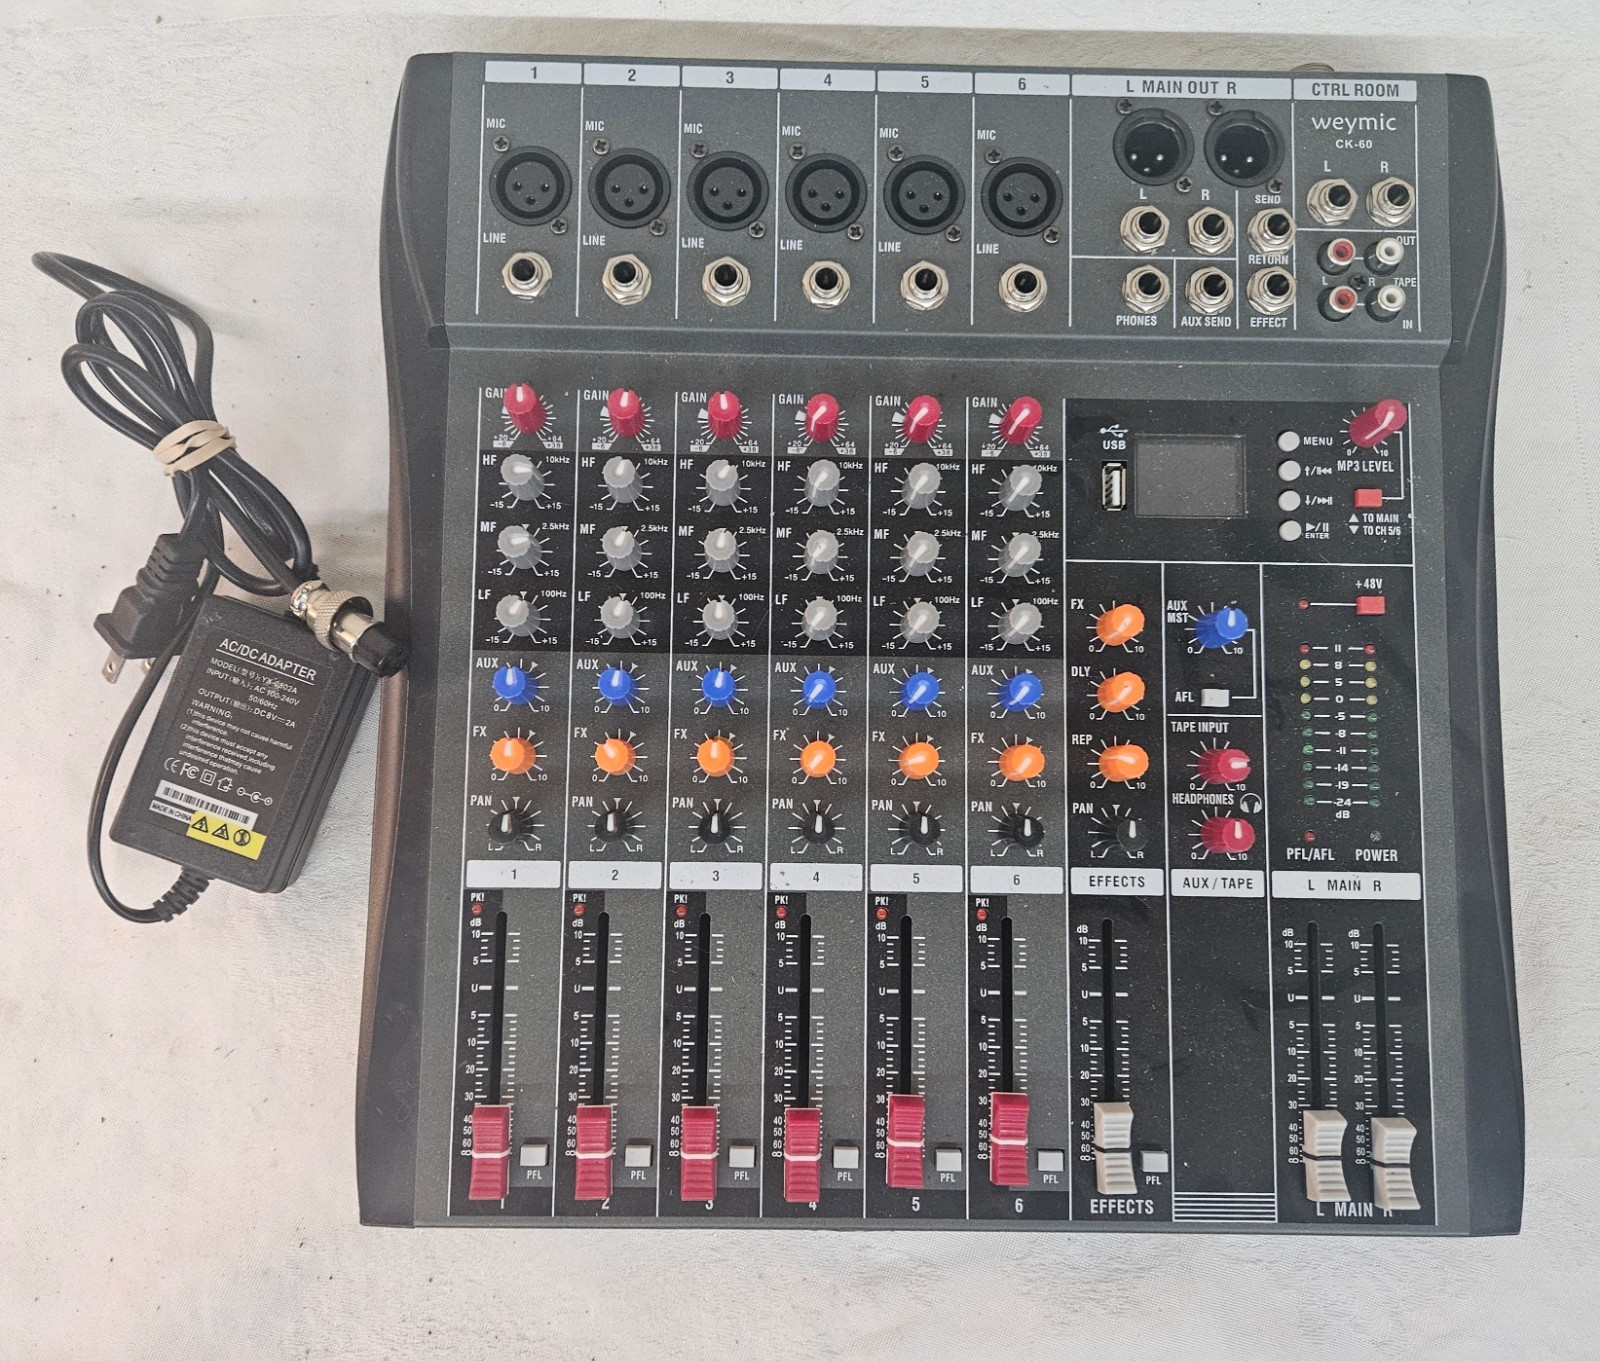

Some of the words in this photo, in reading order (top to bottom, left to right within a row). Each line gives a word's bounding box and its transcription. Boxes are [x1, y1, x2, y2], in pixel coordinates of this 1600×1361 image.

[531, 67, 537, 79] 1
[627, 69, 637, 82] 2
[726, 71, 734, 84] 3
[823, 74, 832, 87] 4
[921, 76, 929, 88] 5
[1018, 78, 1026, 90] 6
[1127, 80, 1134, 93] L
[1142, 81, 1183, 94] MAIN
[1187, 81, 1219, 95] OUT
[1227, 82, 1237, 95] R
[1312, 83, 1350, 97] CTRL
[1354, 84, 1399, 97] ROOM
[486, 118, 506, 129] MIC
[585, 121, 605, 131] MIC
[683, 123, 703, 134] MIC
[1312, 113, 1396, 135] weymic
[782, 126, 801, 136] MIC
[879, 128, 899, 138] MIC
[977, 130, 996, 140] MIC
[1335, 139, 1372, 149] CK-60
[1324, 161, 1331, 172] L
[1380, 161, 1389, 173] R
[1139, 188, 1147, 200] L
[1202, 189, 1210, 201] R
[1254, 194, 1281, 204] SEND
[483, 233, 506, 243] LINE
[582, 235, 606, 246] LINE
[681, 238, 704, 248] LINE
[1396, 236, 1416, 246] OUT
[780, 240, 803, 250] LINE
[878, 242, 901, 252] LINE
[976, 244, 999, 254] LINE
[1248, 255, 1289, 265] RETURN
[1322, 277, 1328, 286] L
[1368, 278, 1376, 287] R
[1393, 277, 1417, 288] TAPE
[1116, 315, 1157, 327] PHONES
[1181, 316, 1202, 327] AUX
[1204, 316, 1232, 328] SEND
[1250, 317, 1288, 328] EFFECT
[1403, 319, 1413, 329] IN
[584, 390, 609, 400] GAIN
[681, 392, 707, 403] GAIN
[875, 395, 901, 407] GAIN
[972, 397, 998, 408] GAIN
[1103, 440, 1126, 450] USB
[1304, 437, 1333, 446] MENU
[483, 454, 497, 465] HF
[545, 456, 570, 464] 10kHz
[680, 459, 693, 470] HF
[874, 462, 888, 473] HF
[1337, 460, 1360, 472] MP3
[1363, 461, 1394, 472] LEVEL
[546, 502, 561, 510] +15
[1363, 514, 1374, 523] TO
[1376, 514, 1399, 523] MAIN
[480, 521, 497, 532] MF
[542, 522, 570, 531] 2.5kHz
[678, 526, 694, 536] MF
[1363, 526, 1374, 535] TO
[1375, 526, 1387, 535] CH
[1388, 526, 1401, 536] 5/6
[874, 529, 890, 540] MF
[1355, 578, 1382, 589] +48V
[478, 589, 491, 600] LF
[541, 590, 567, 598] 100Hz
[677, 593, 690, 603] LF
[873, 596, 886, 607] LF
[1071, 599, 1084, 609] FX
[1167, 600, 1188, 611] AUX
[1167, 613, 1189, 623] MST
[220, 638, 259, 659] AC/DC
[258, 652, 317, 681] ADAPTER
[476, 658, 498, 668] AUX
[576, 659, 599, 670] AUX
[676, 660, 698, 671] AUX
[774, 662, 797, 673] AUX
[873, 663, 895, 674] AUX
[971, 665, 994, 676] AUX
[1334, 661, 1343, 670] 8
[1071, 666, 1090, 677] DLY
[1335, 678, 1343, 686] 5
[254, 686, 266, 694] AC
[248, 694, 278, 710] 50/60Hz
[1175, 692, 1194, 702] AFL
[1335, 695, 1344, 703] 0
[191, 699, 233, 719] WARNING:
[493, 704, 499, 712] 0
[206, 716, 226, 727] device
[226, 723, 240, 732] may
[240, 728, 251, 736] not
[250, 732, 270, 742] cause
[473, 726, 487, 737] FX
[1171, 722, 1196, 732] TAPE
[1199, 722, 1229, 733] INPUT
[674, 729, 687, 739] FX
[872, 731, 885, 742] FX
[1072, 734, 1093, 745] REP
[235, 744, 257, 755] accept
[256, 752, 269, 760] any
[470, 795, 492, 806] PAN
[572, 796, 593, 807] PAN
[672, 797, 693, 808] PAN
[772, 799, 793, 809] PAN
[1172, 793, 1234, 805] HEADPHONES
[872, 800, 893, 811] PAN
[971, 801, 992, 812] PAN
[1073, 803, 1094, 814] PAN
[152, 802, 168, 812] MADE
[174, 809, 192, 822] CHINA
[1336, 810, 1350, 819] dB
[1287, 848, 1335, 861] PFL/AFL
[1355, 849, 1398, 862] POWER
[511, 869, 516, 880] 1
[612, 870, 619, 881] 2
[713, 871, 719, 882] 3
[813, 872, 819, 883] 4
[913, 873, 920, 884] 5
[1013, 875, 1020, 885] 6
[1089, 875, 1145, 887] EFFECTS
[1183, 877, 1209, 889] AUX
[1221, 878, 1253, 889] TAPE
[1308, 879, 1315, 890] L
[1327, 880, 1361, 891] MAIN
[1373, 880, 1382, 891] R
[470, 893, 485, 902] PK!
[674, 894, 688, 904] PK!
[875, 897, 889, 906] PK!
[470, 918, 482, 927] dB
[472, 930, 481, 938] 10
[473, 957, 479, 965] 5
[471, 984, 478, 993] U
[465, 1065, 475, 1074] 20
[465, 1092, 474, 1101] 30
[527, 1170, 542, 1180] PFL
[734, 1171, 749, 1181] PFL
[1043, 1174, 1059, 1184] PFL
[1146, 1176, 1161, 1185] PFL
[912, 1197, 920, 1211] 5
[1015, 1198, 1023, 1213] 6
[1091, 1199, 1154, 1214] EFFECTS
[1316, 1202, 1325, 1216] L
[1335, 1202, 1373, 1217] MAIN
